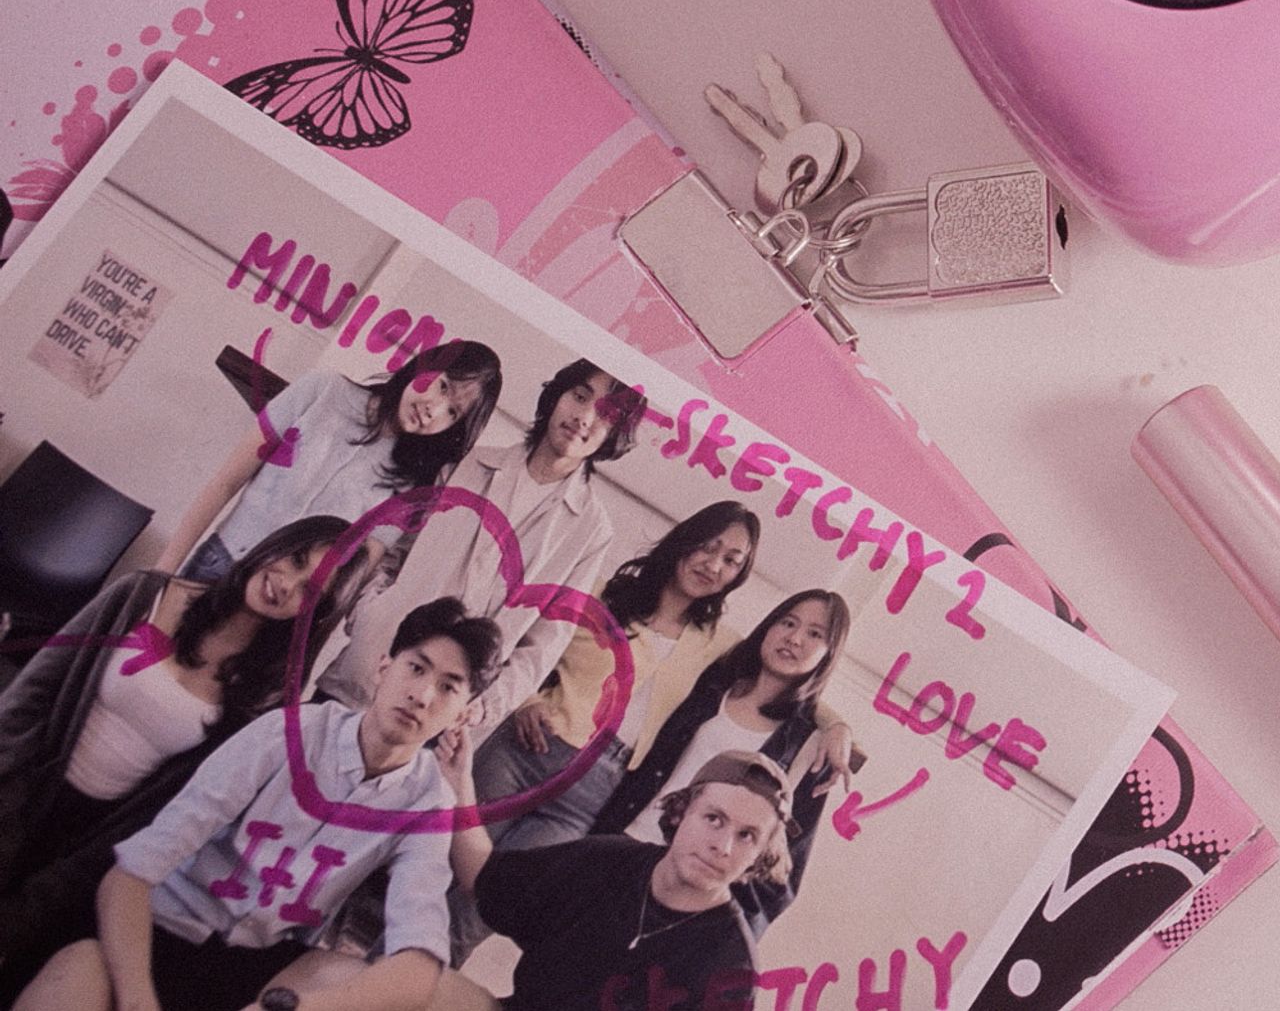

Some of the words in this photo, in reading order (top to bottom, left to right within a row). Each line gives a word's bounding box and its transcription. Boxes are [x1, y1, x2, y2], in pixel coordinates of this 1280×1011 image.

[62, 297, 99, 330] WHO
[96, 253, 148, 297] YOU'RE
[141, 286, 158, 305] A
[659, 398, 947, 616] SKETCHY
[944, 569, 987, 641] 2
[872, 651, 1048, 791] LOVE
